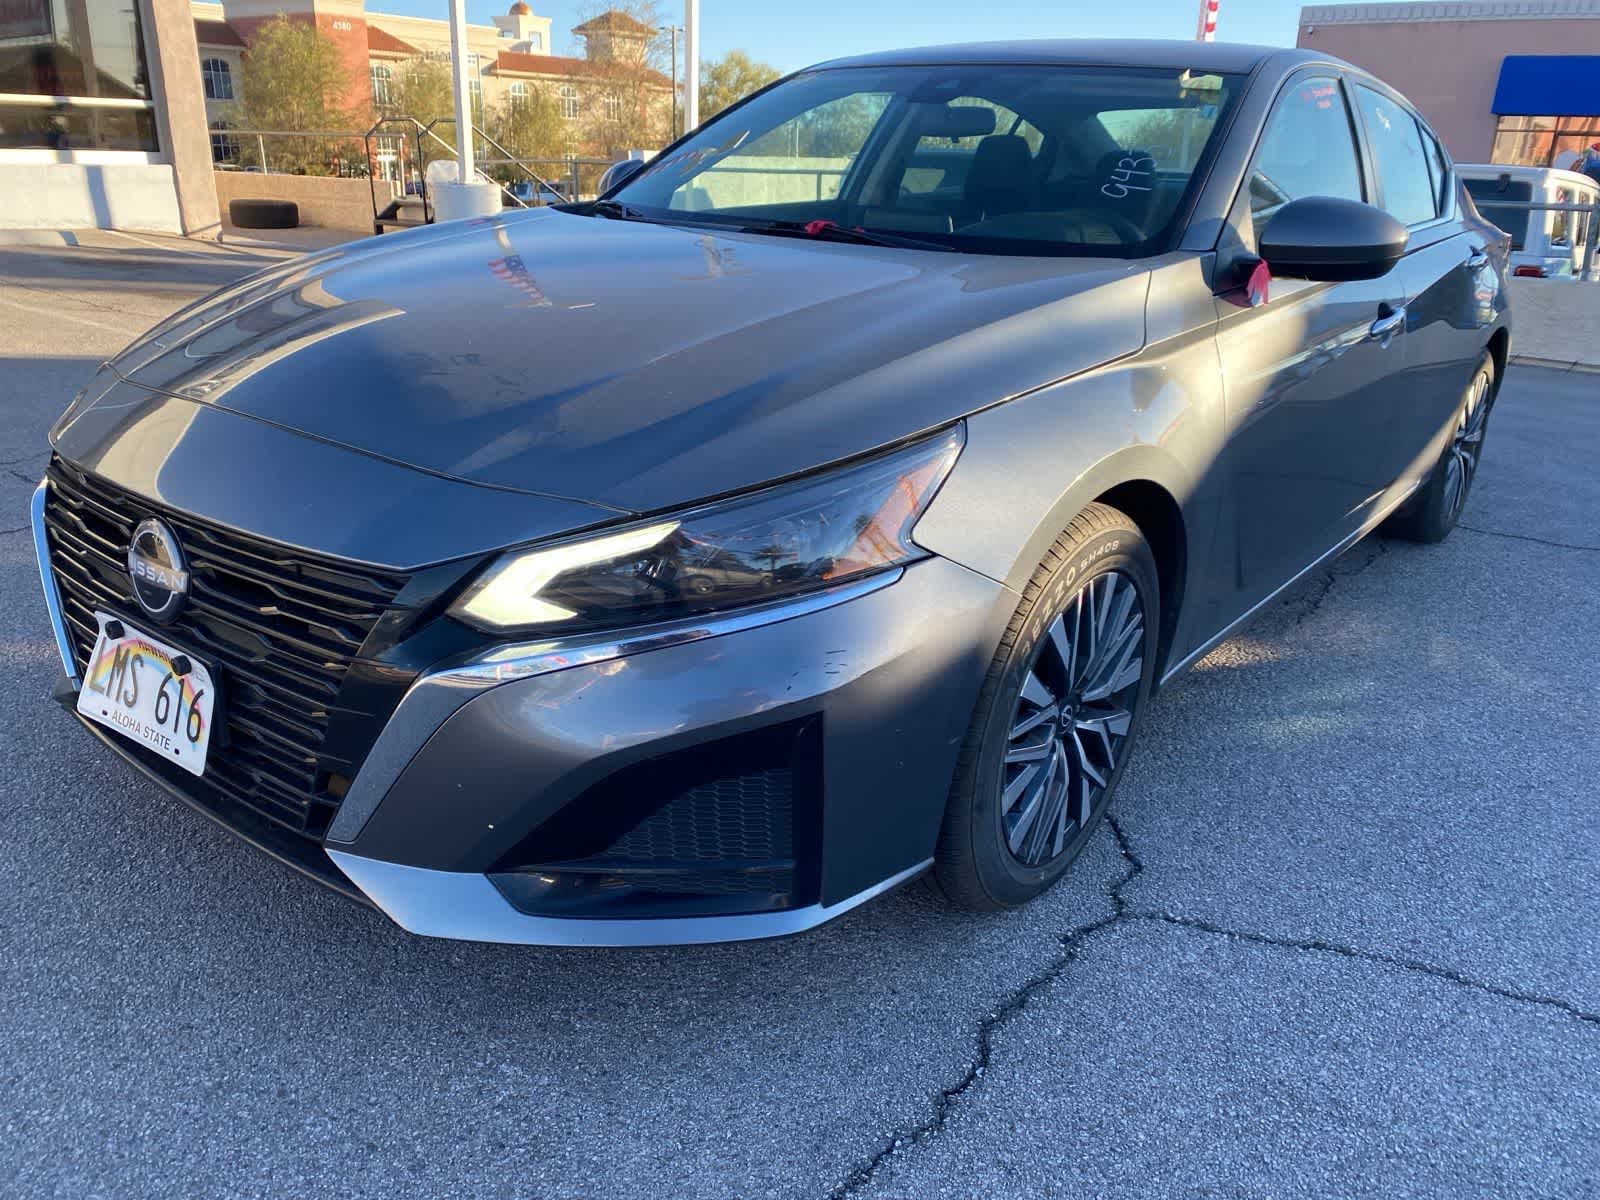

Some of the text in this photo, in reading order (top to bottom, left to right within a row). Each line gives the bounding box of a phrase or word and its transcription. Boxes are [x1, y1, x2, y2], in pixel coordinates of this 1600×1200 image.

[89, 636, 204, 743] LMS 616
[111, 711, 171, 750] ALOHA STATE
